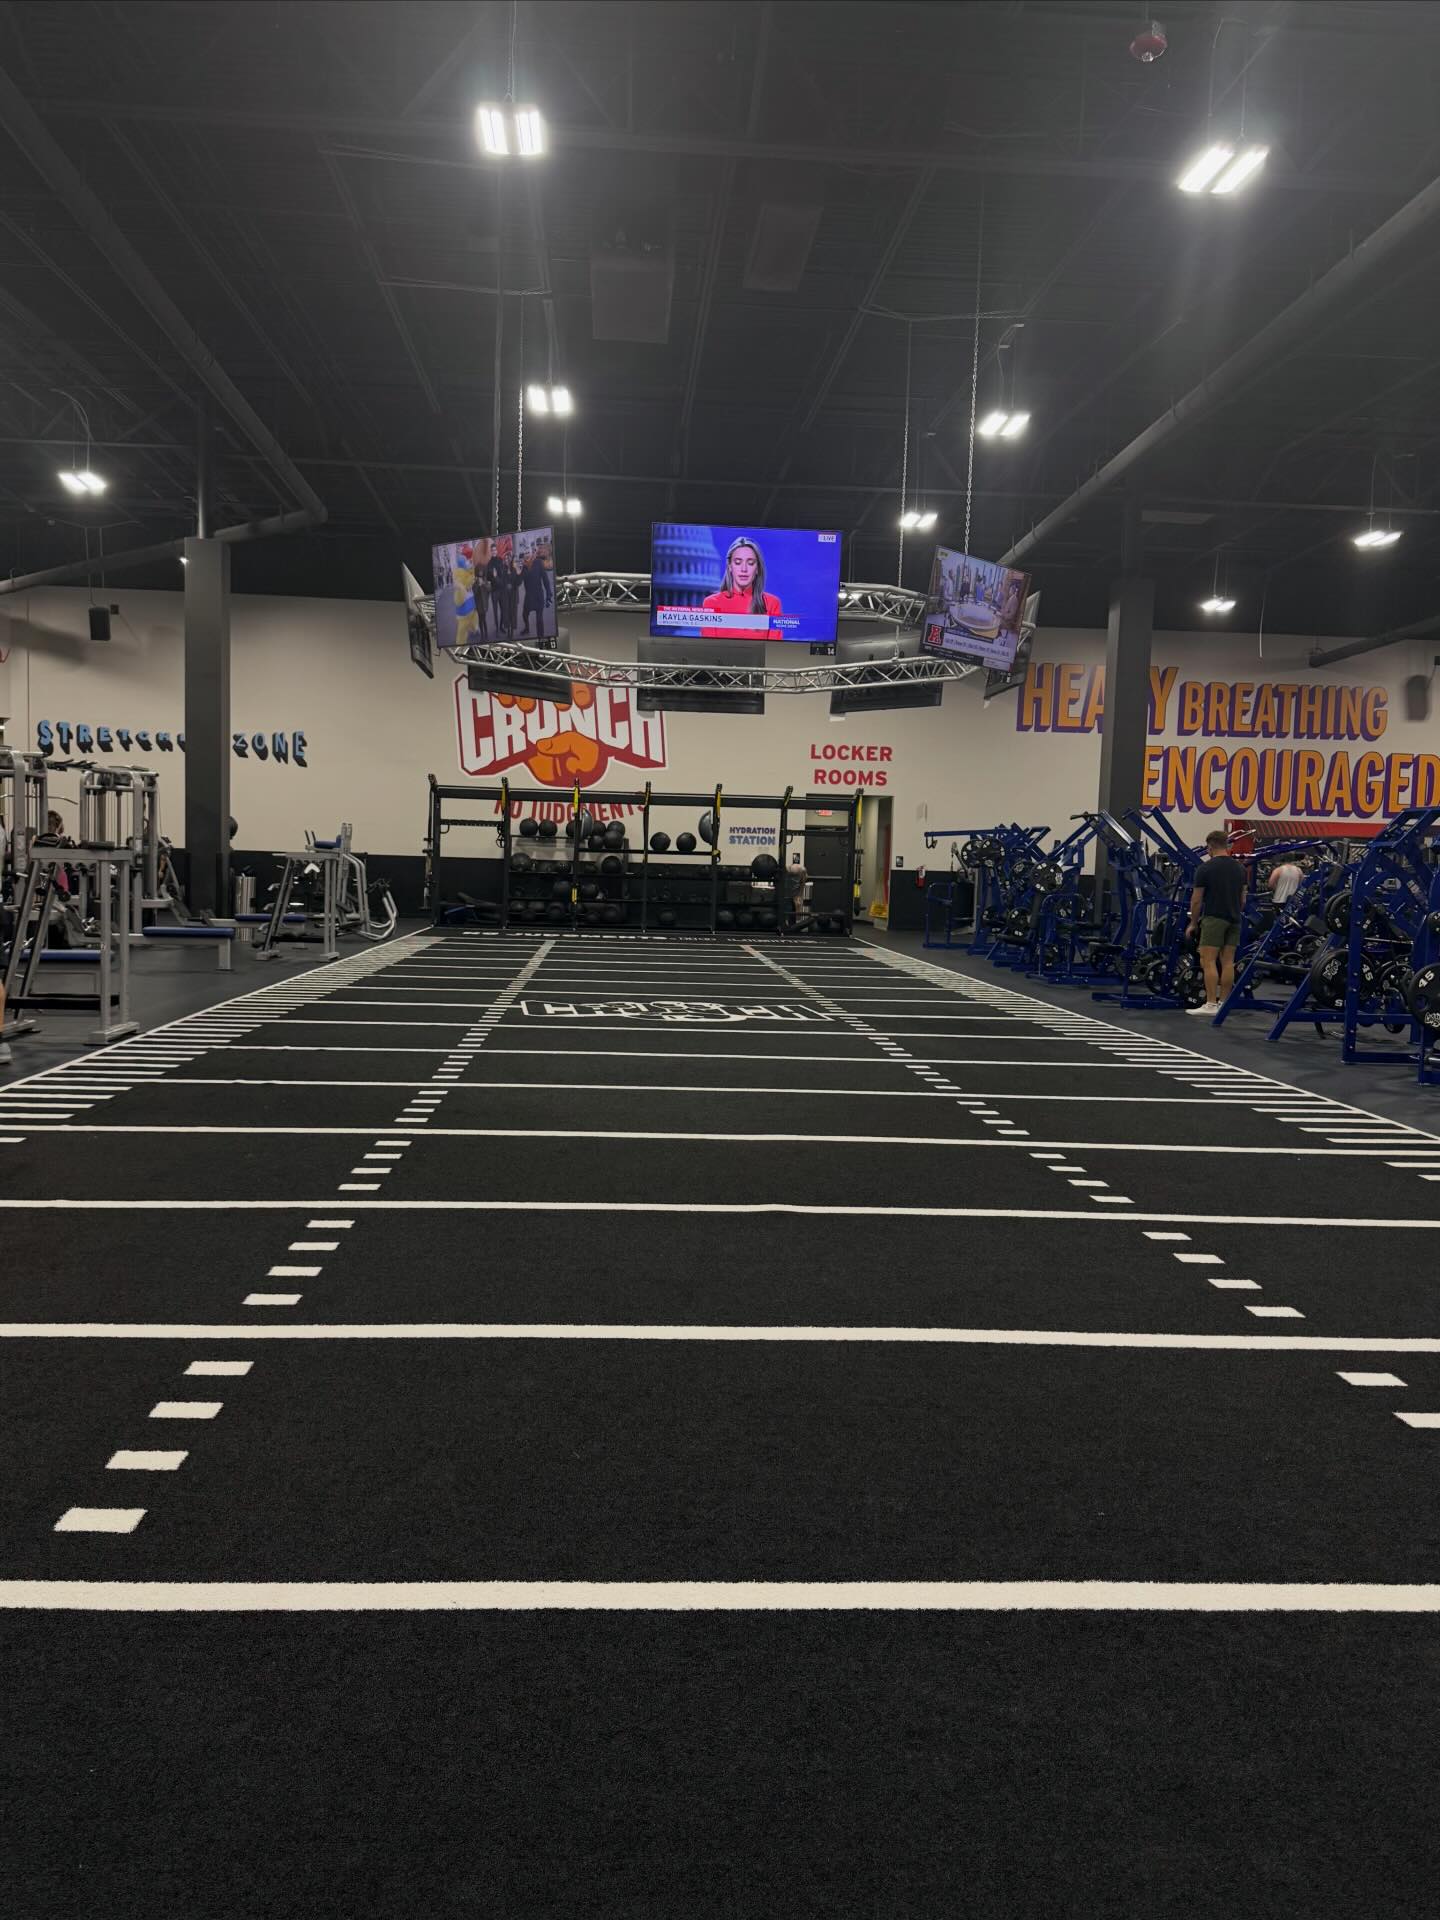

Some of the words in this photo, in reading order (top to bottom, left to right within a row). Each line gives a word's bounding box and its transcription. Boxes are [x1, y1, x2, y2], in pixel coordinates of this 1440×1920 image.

[662, 613, 687, 621] KAYLA
[689, 614, 723, 623] GASKINS
[827, 647, 835, 655] 14
[1016, 662, 1179, 735] HEAY
[1177, 680, 1389, 742] BREATHING
[455, 673, 667, 776] CRUNCH
[232, 731, 308, 767] ZONE
[810, 744, 892, 761] LOCKER
[814, 769, 888, 786] ROOMS
[1142, 745, 1440, 819] ENCOURAGED
[730, 826, 776, 834] HYDRATION
[729, 835, 776, 845] STATION
[1362, 963, 1374, 981] 45
[1418, 970, 1435, 988] 45
